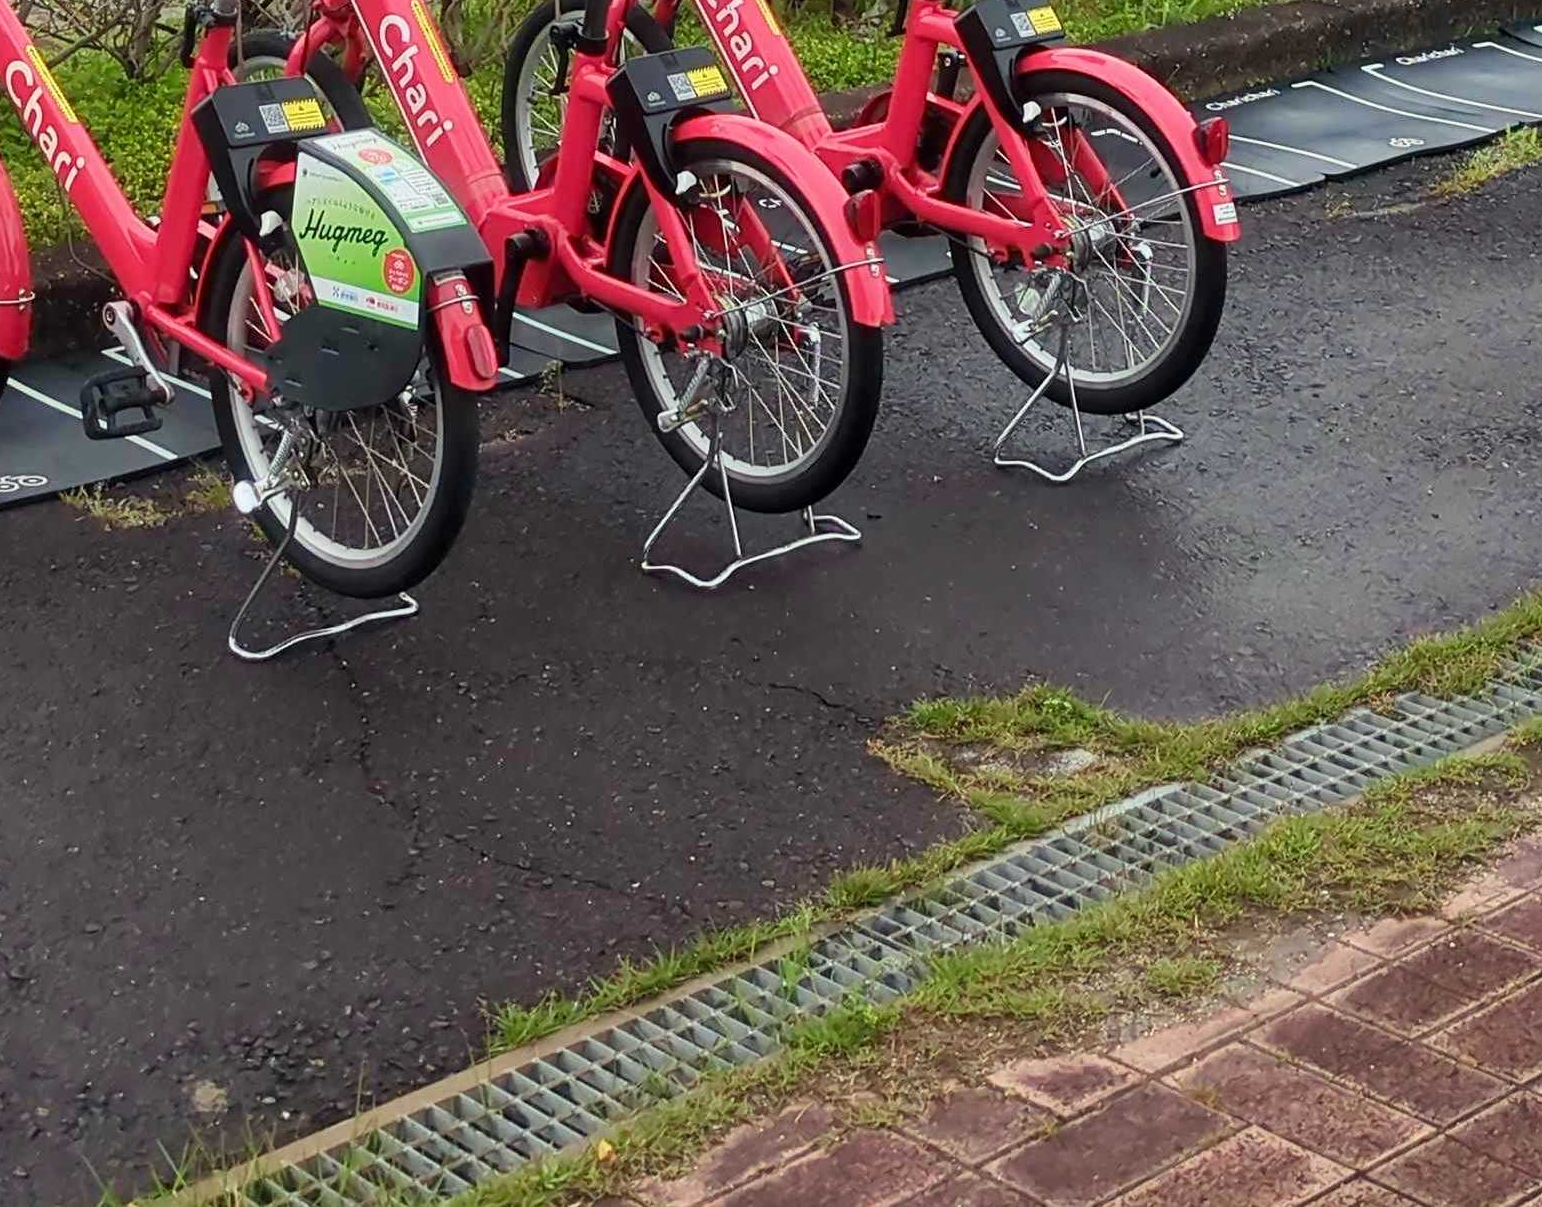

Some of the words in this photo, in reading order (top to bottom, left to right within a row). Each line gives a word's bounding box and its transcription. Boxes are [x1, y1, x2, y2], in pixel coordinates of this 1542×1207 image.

[5, 60, 85, 192] Chari
[379, 14, 454, 147] Chari
[299, 208, 389, 258] Hugmeg
